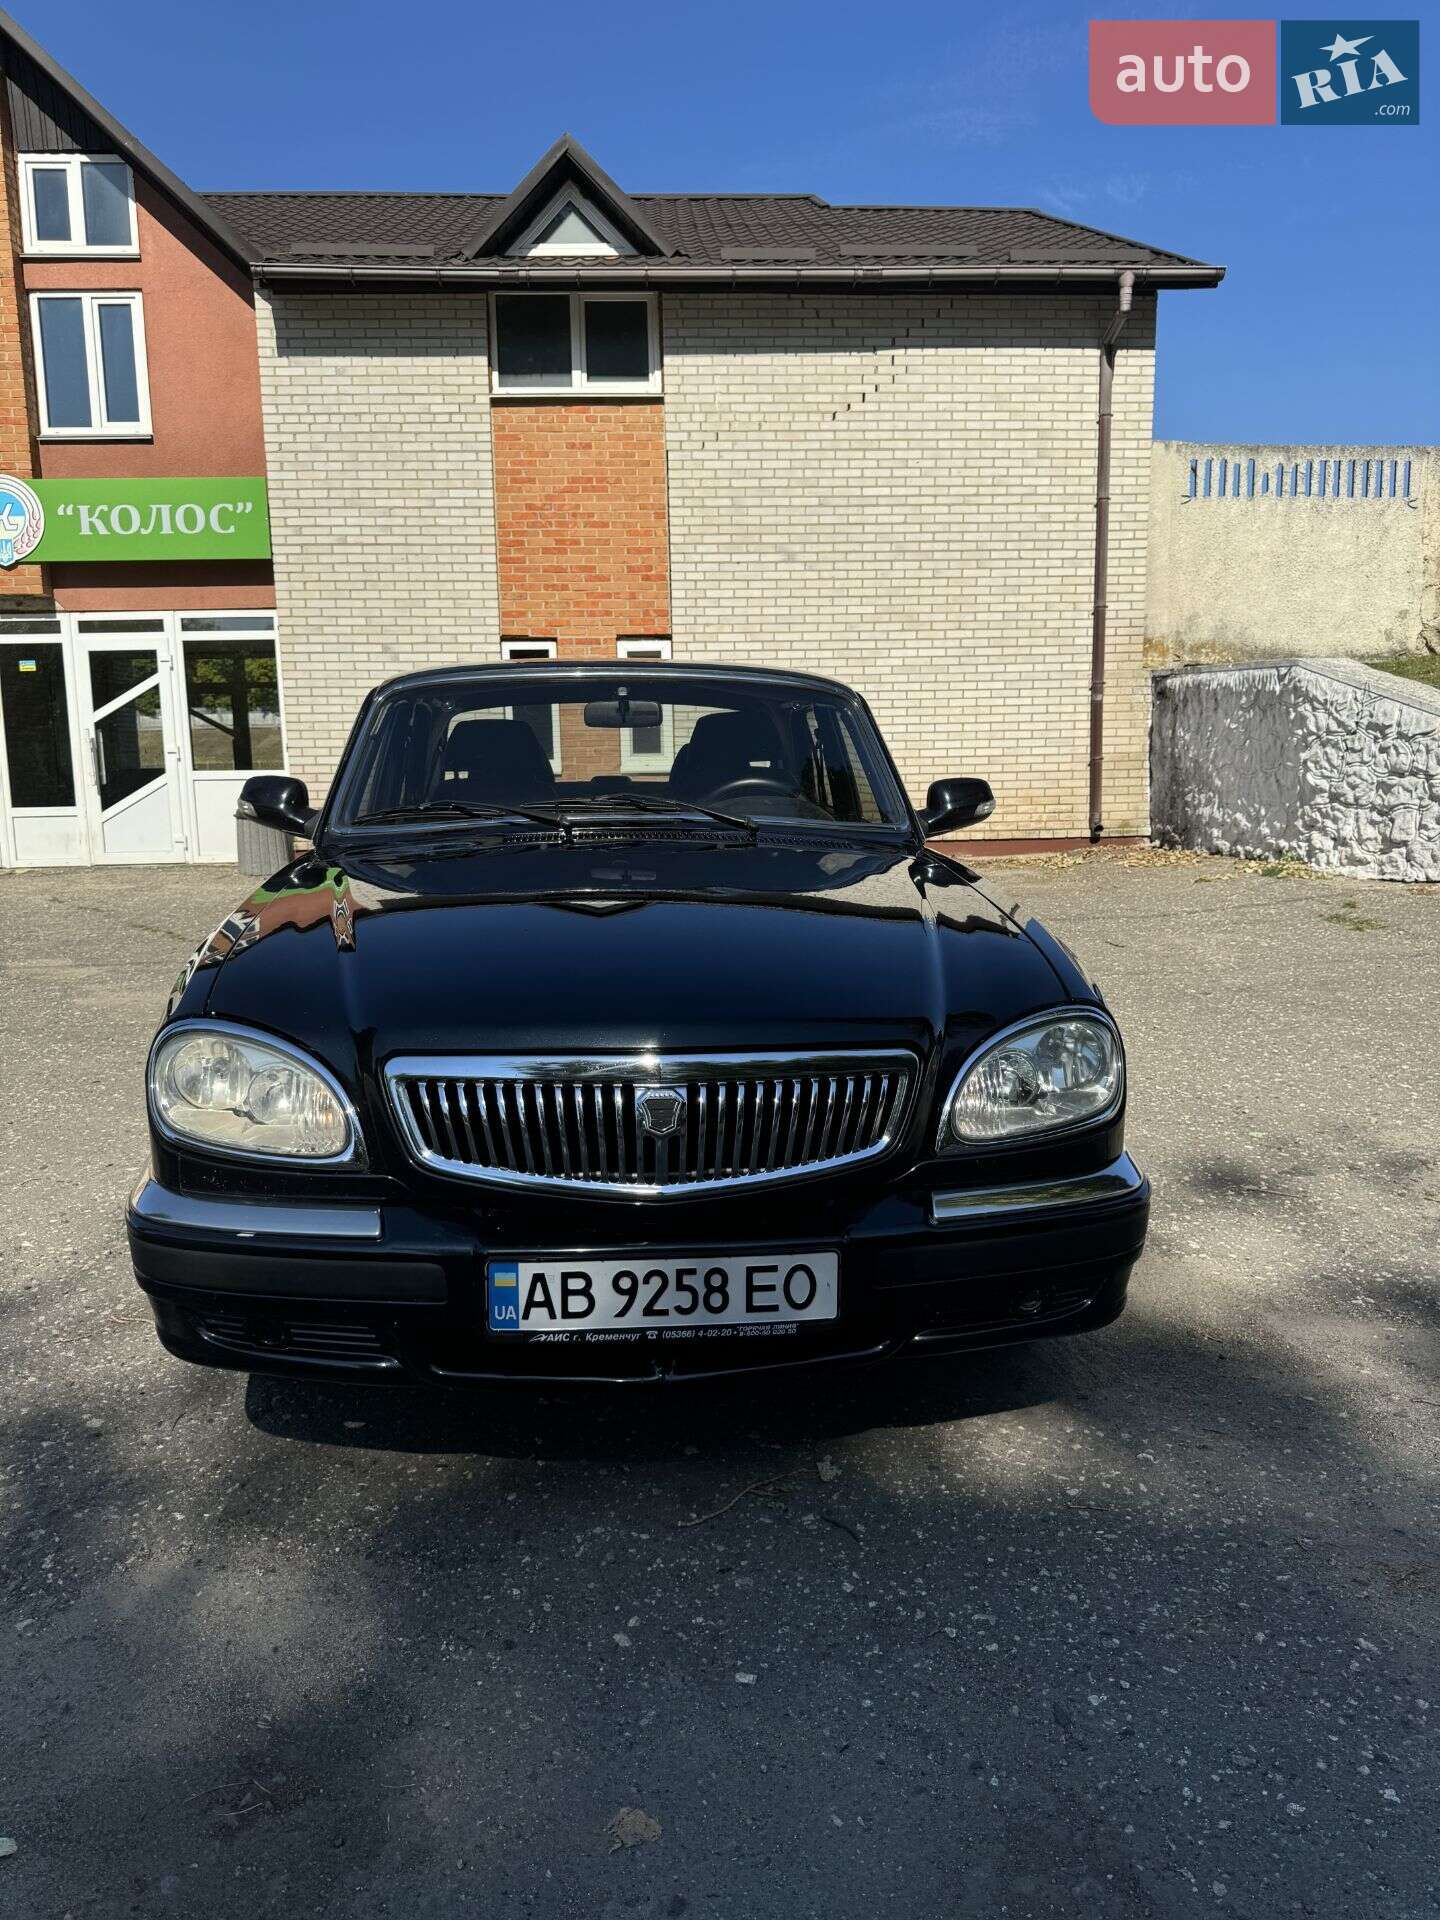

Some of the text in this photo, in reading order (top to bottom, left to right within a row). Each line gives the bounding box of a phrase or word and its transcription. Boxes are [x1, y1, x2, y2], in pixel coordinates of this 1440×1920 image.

[521, 1263, 817, 1321] AB 9258 EO
[494, 1305, 517, 1320] UA
[586, 1332, 641, 1343] Кременчуг
